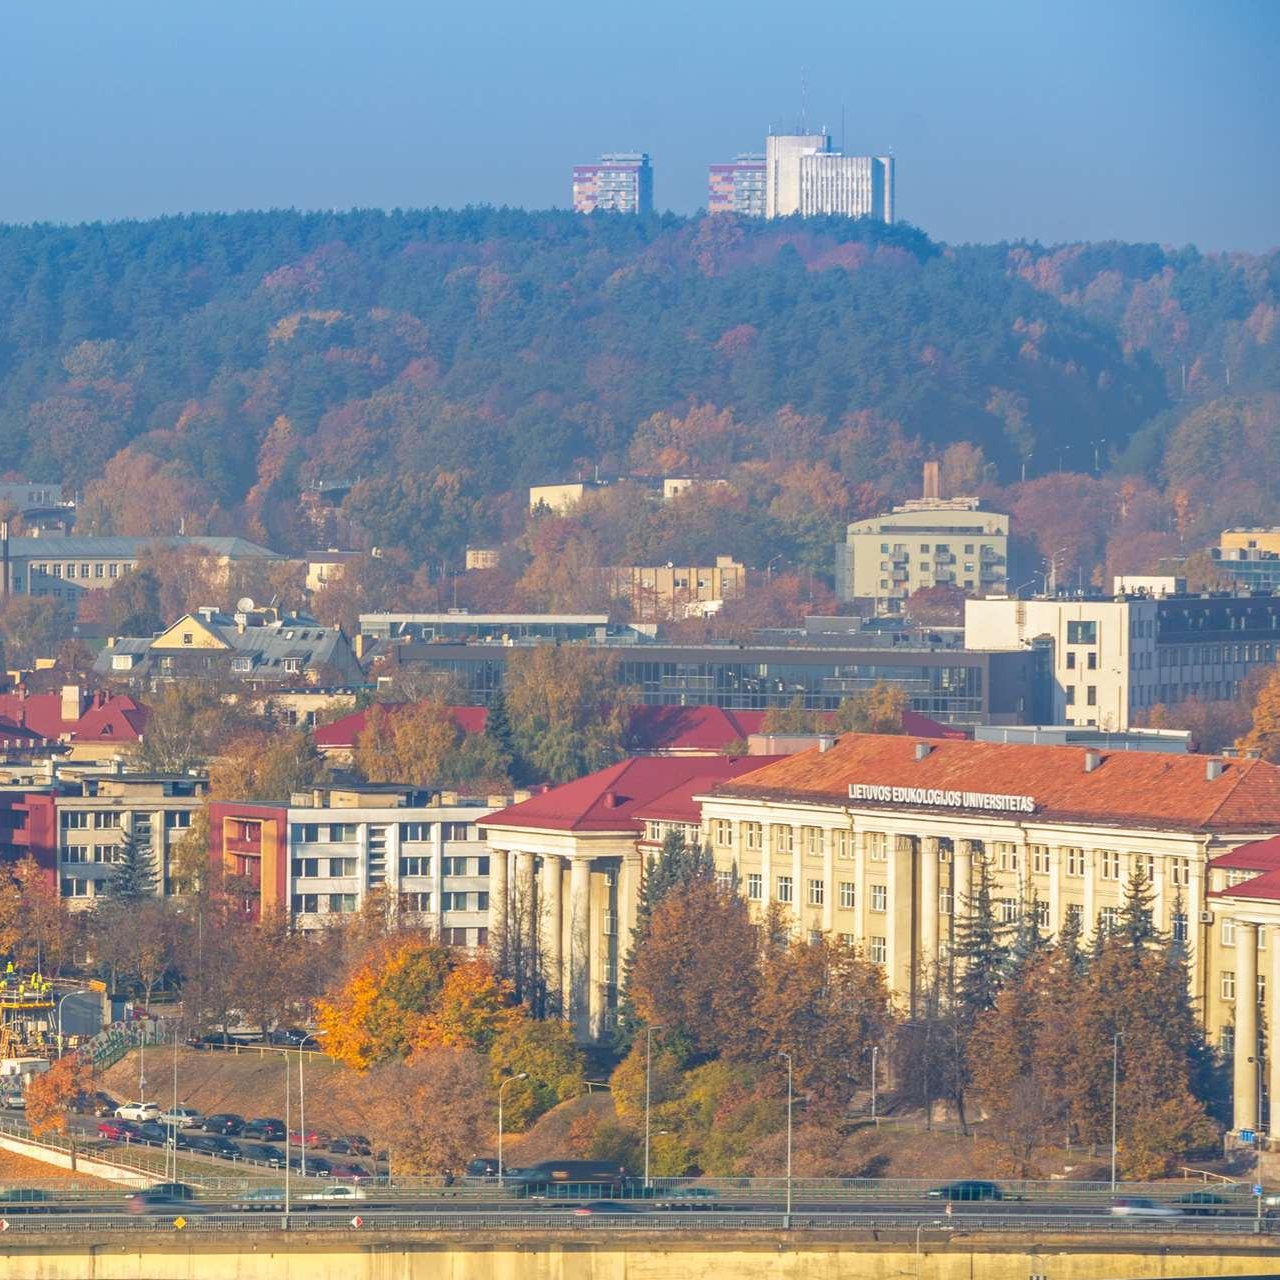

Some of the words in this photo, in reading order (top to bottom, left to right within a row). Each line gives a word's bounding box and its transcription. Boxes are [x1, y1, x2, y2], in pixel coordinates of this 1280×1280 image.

[848, 784, 892, 800] LIETUVOS
[893, 787, 962, 806] EDUKOLOGIJOS
[963, 792, 1034, 812] UNIVERSITETAS
